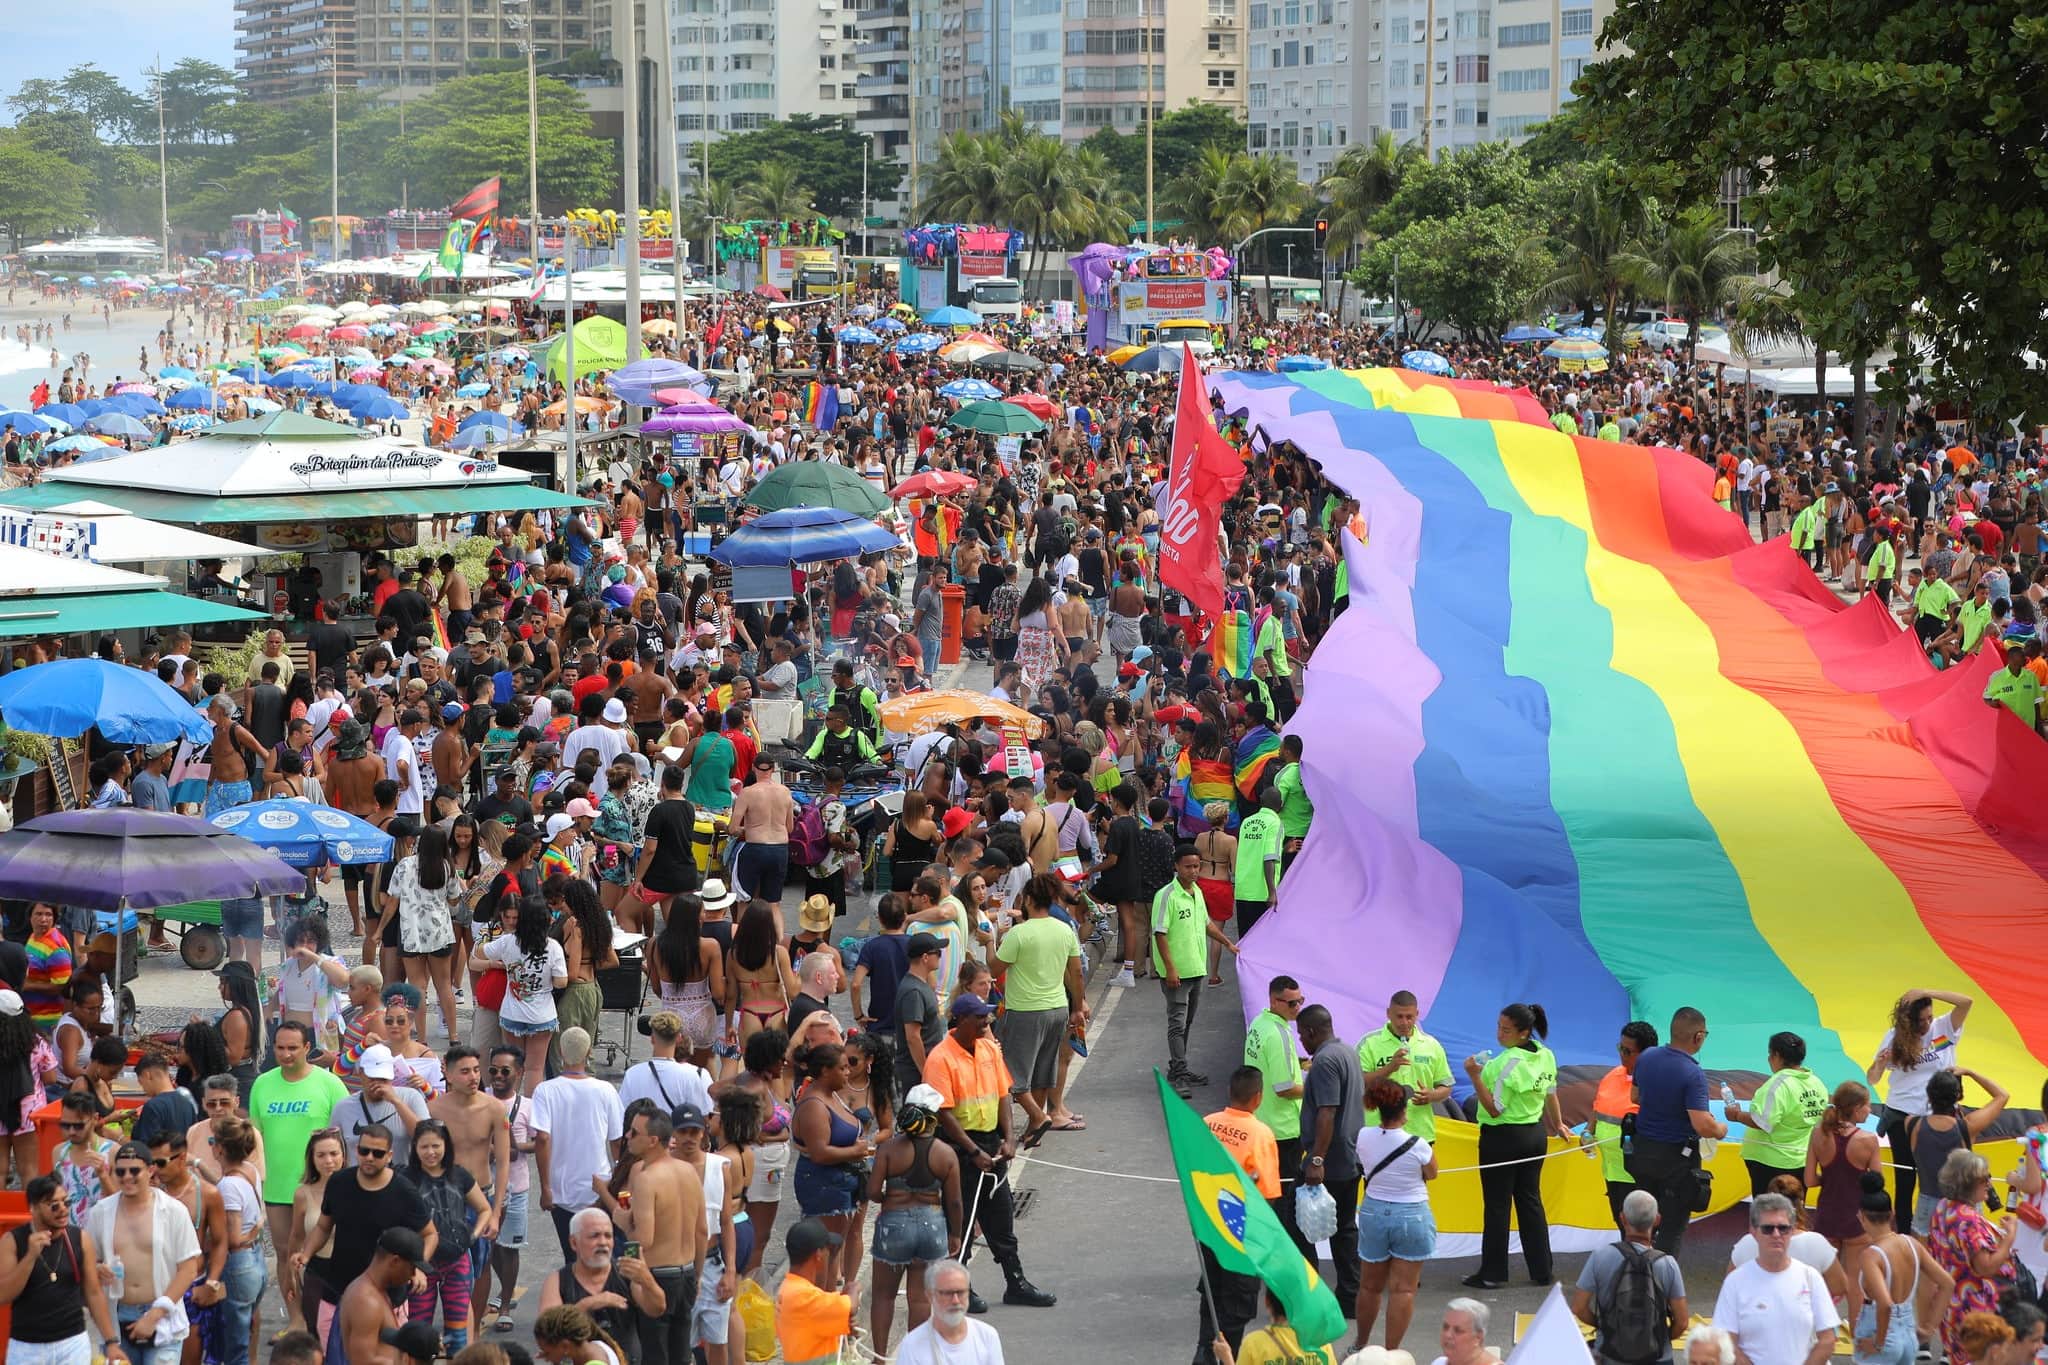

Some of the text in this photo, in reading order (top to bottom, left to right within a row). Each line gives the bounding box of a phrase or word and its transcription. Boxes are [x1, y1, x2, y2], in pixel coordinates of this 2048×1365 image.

[308, 451, 424, 474] Botequim da Praia
[646, 636, 664, 653] 36
[264, 812, 294, 823] bet
[1178, 908, 1191, 920] 23
[267, 1100, 312, 1114] SLICE
